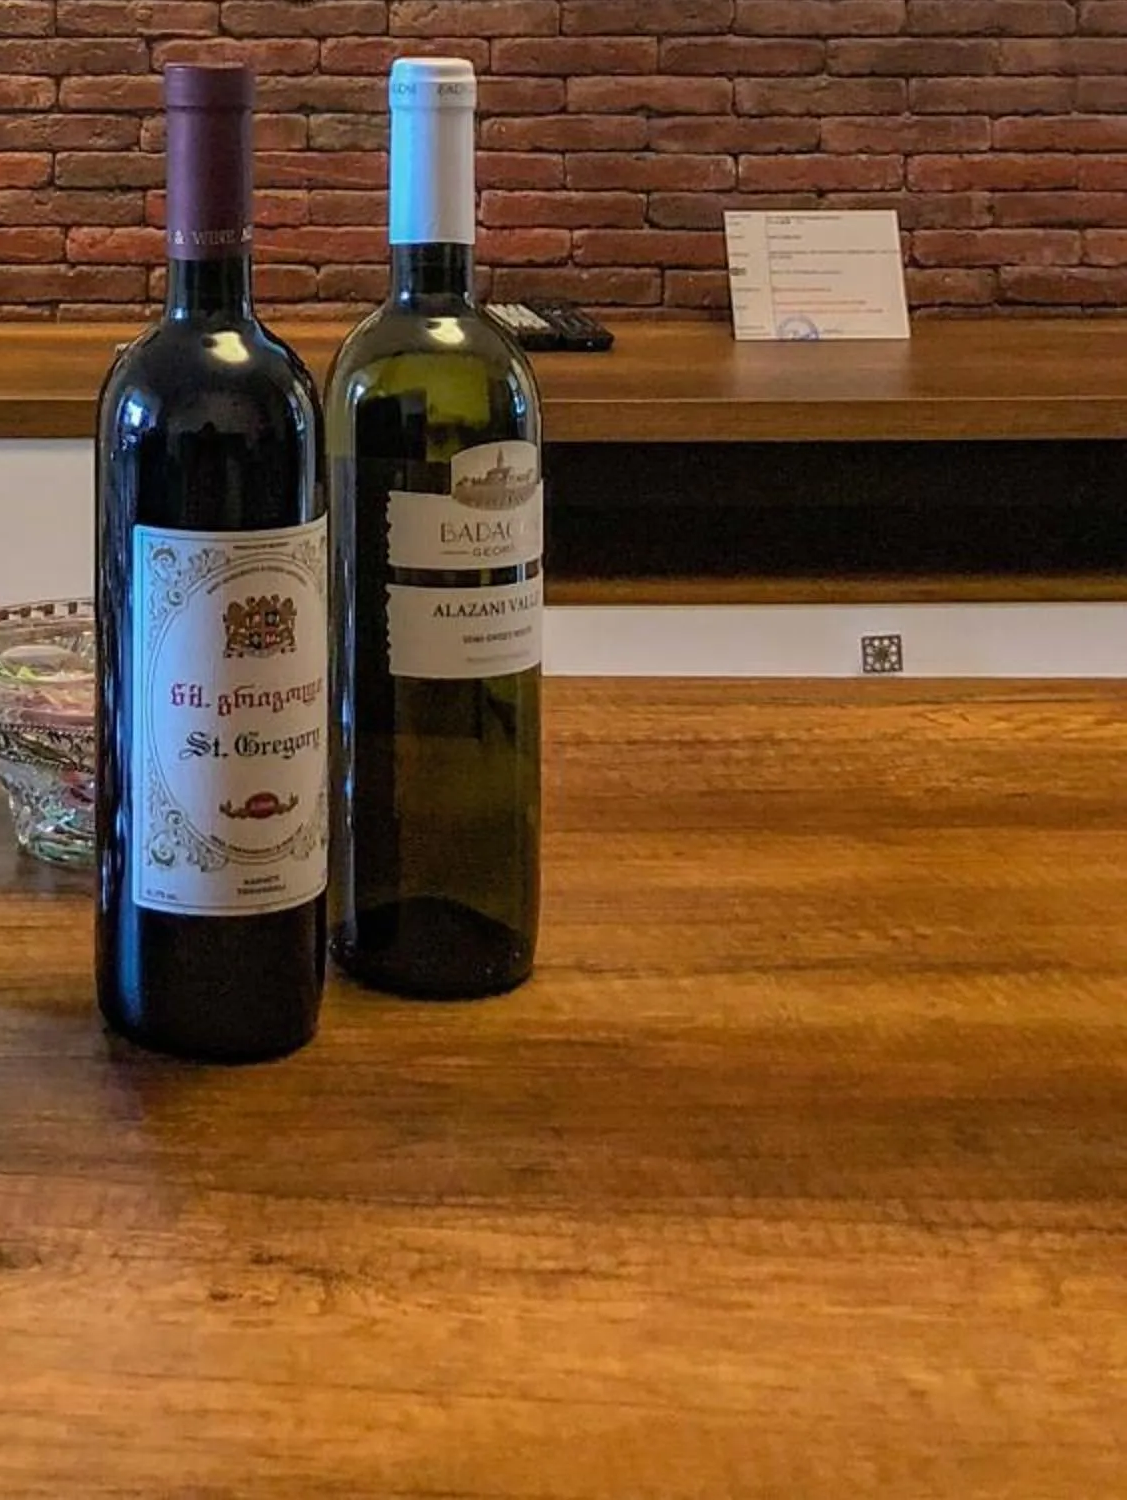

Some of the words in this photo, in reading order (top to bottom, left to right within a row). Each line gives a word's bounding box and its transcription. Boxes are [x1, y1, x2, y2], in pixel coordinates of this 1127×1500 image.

[432, 600, 506, 618] ALAZANI
[179, 730, 229, 760] St.
[233, 727, 320, 760] Gregory
